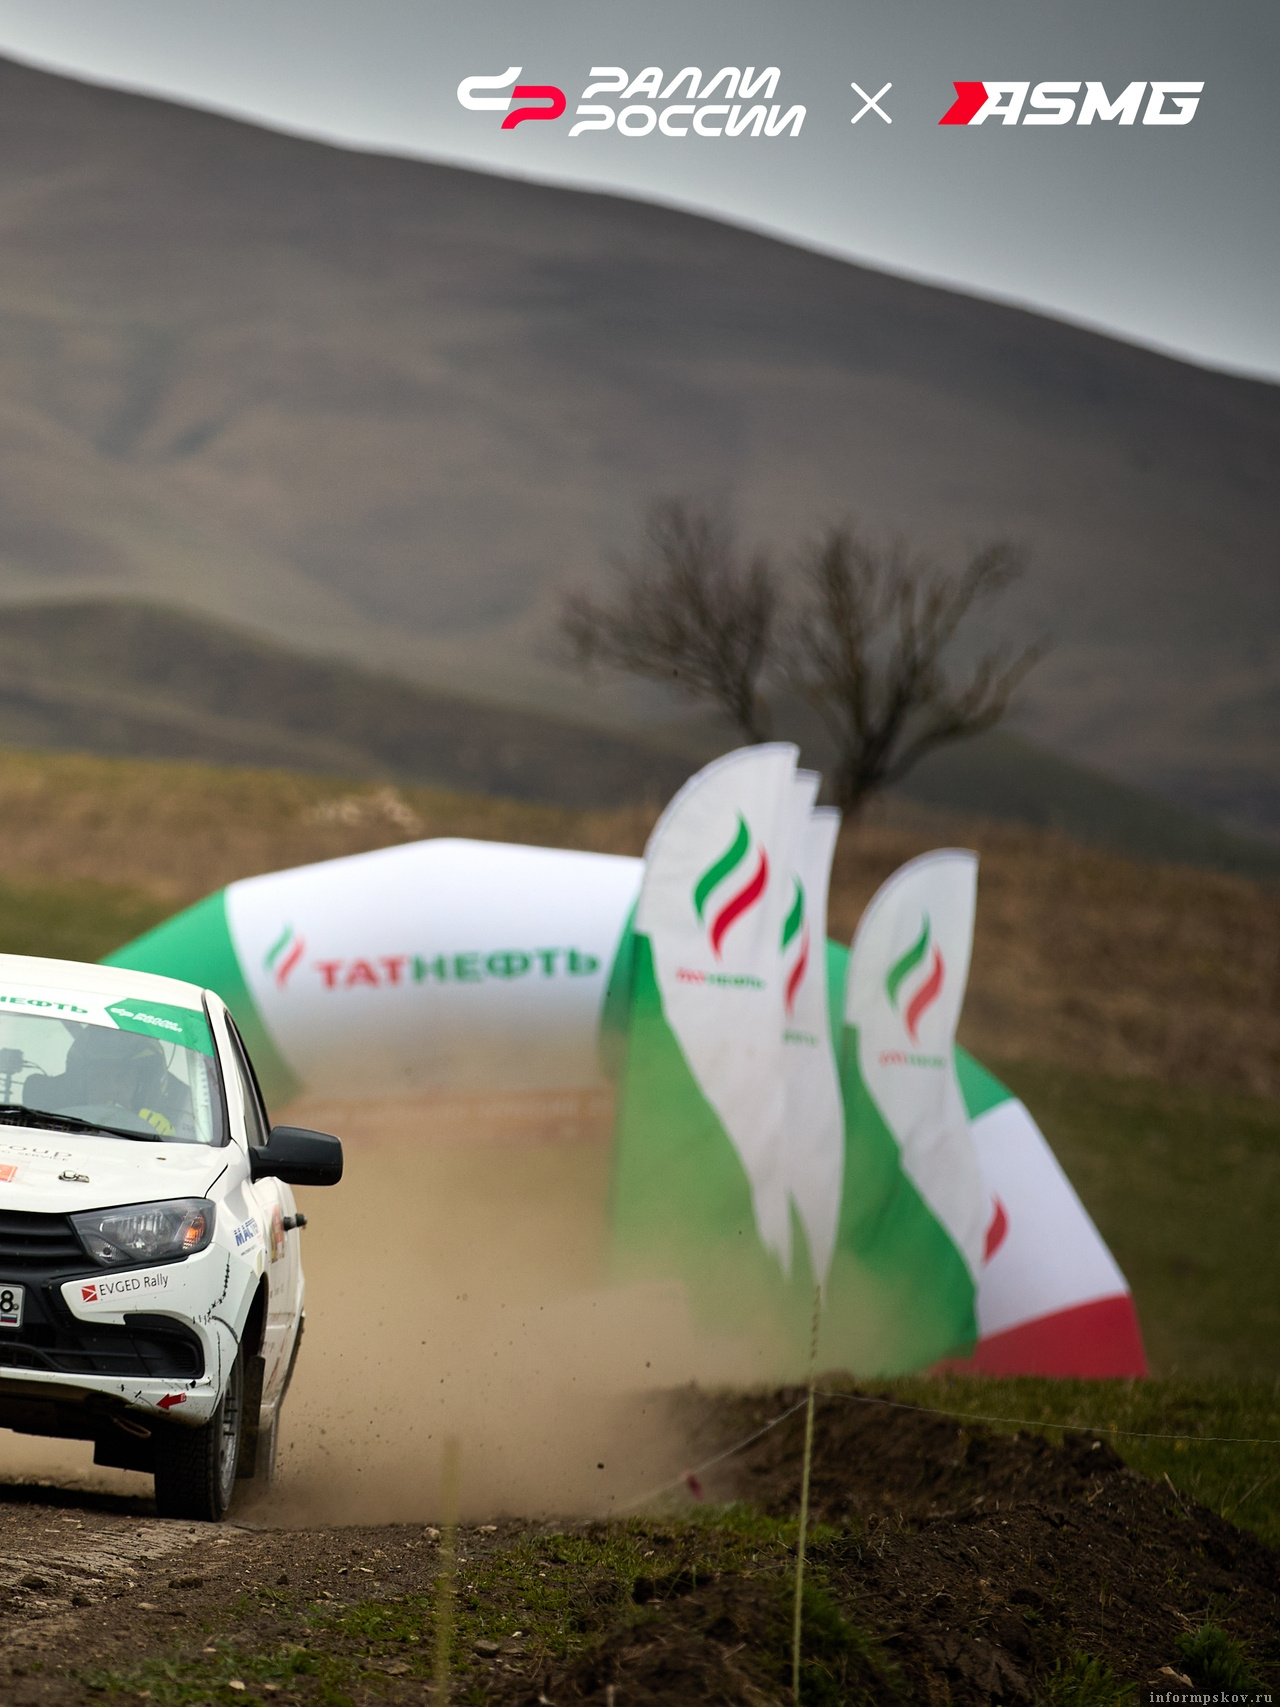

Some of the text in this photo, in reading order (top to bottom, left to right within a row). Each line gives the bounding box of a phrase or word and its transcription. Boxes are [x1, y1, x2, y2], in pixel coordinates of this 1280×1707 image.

[316, 946, 601, 990] ТАТНЕФТЬ
[99, 1273, 169, 1296] EVGED Rally
